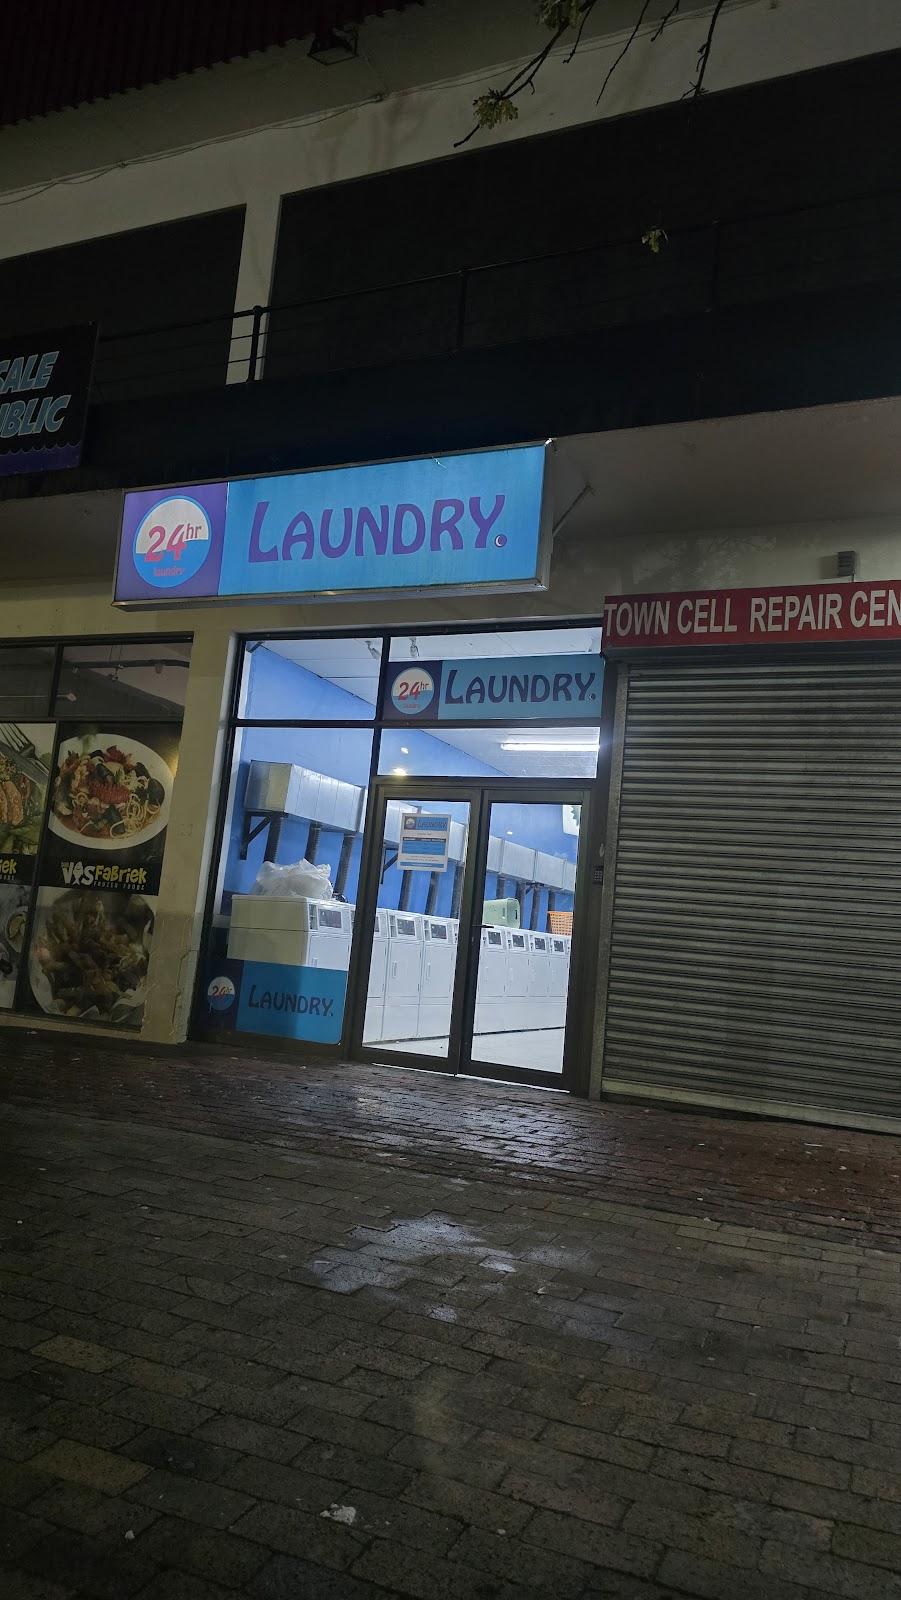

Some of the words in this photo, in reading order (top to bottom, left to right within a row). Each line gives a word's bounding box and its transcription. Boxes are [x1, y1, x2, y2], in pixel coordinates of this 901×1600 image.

[153, 567, 186, 577] laundry
[603, 600, 671, 637] TOWN
[677, 598, 738, 635] CELL
[750, 593, 842, 633] REPAIR
[93, 880, 118, 888] FROZEN
